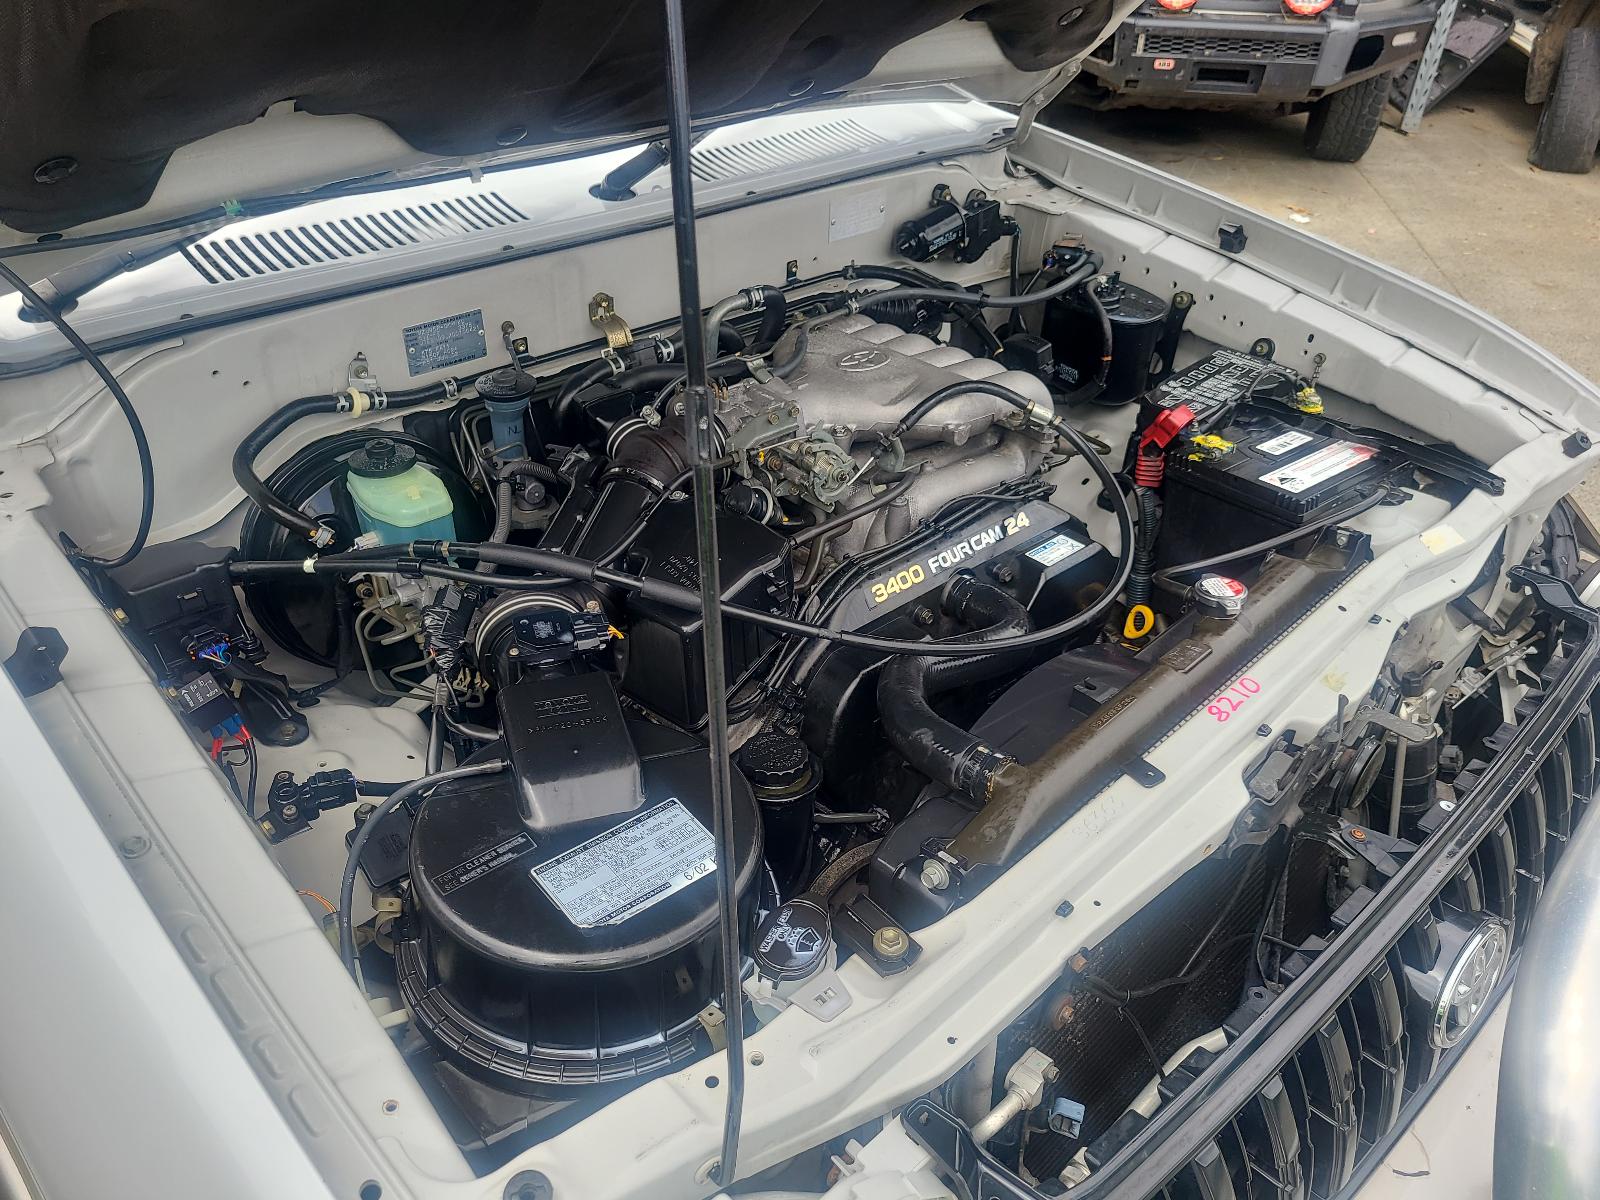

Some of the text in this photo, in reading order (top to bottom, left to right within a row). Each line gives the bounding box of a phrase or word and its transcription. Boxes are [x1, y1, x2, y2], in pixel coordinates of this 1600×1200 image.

[871, 564, 925, 604] 3400
[927, 542, 975, 575] FOUR
[970, 525, 1004, 552] CAM
[1003, 511, 1030, 536] 24
[1207, 677, 1261, 722] 8210
[465, 850, 497, 870] CLEANER
[683, 862, 710, 881] 6/02
[444, 880, 460, 891] SEE
[759, 924, 780, 952] WASHER
